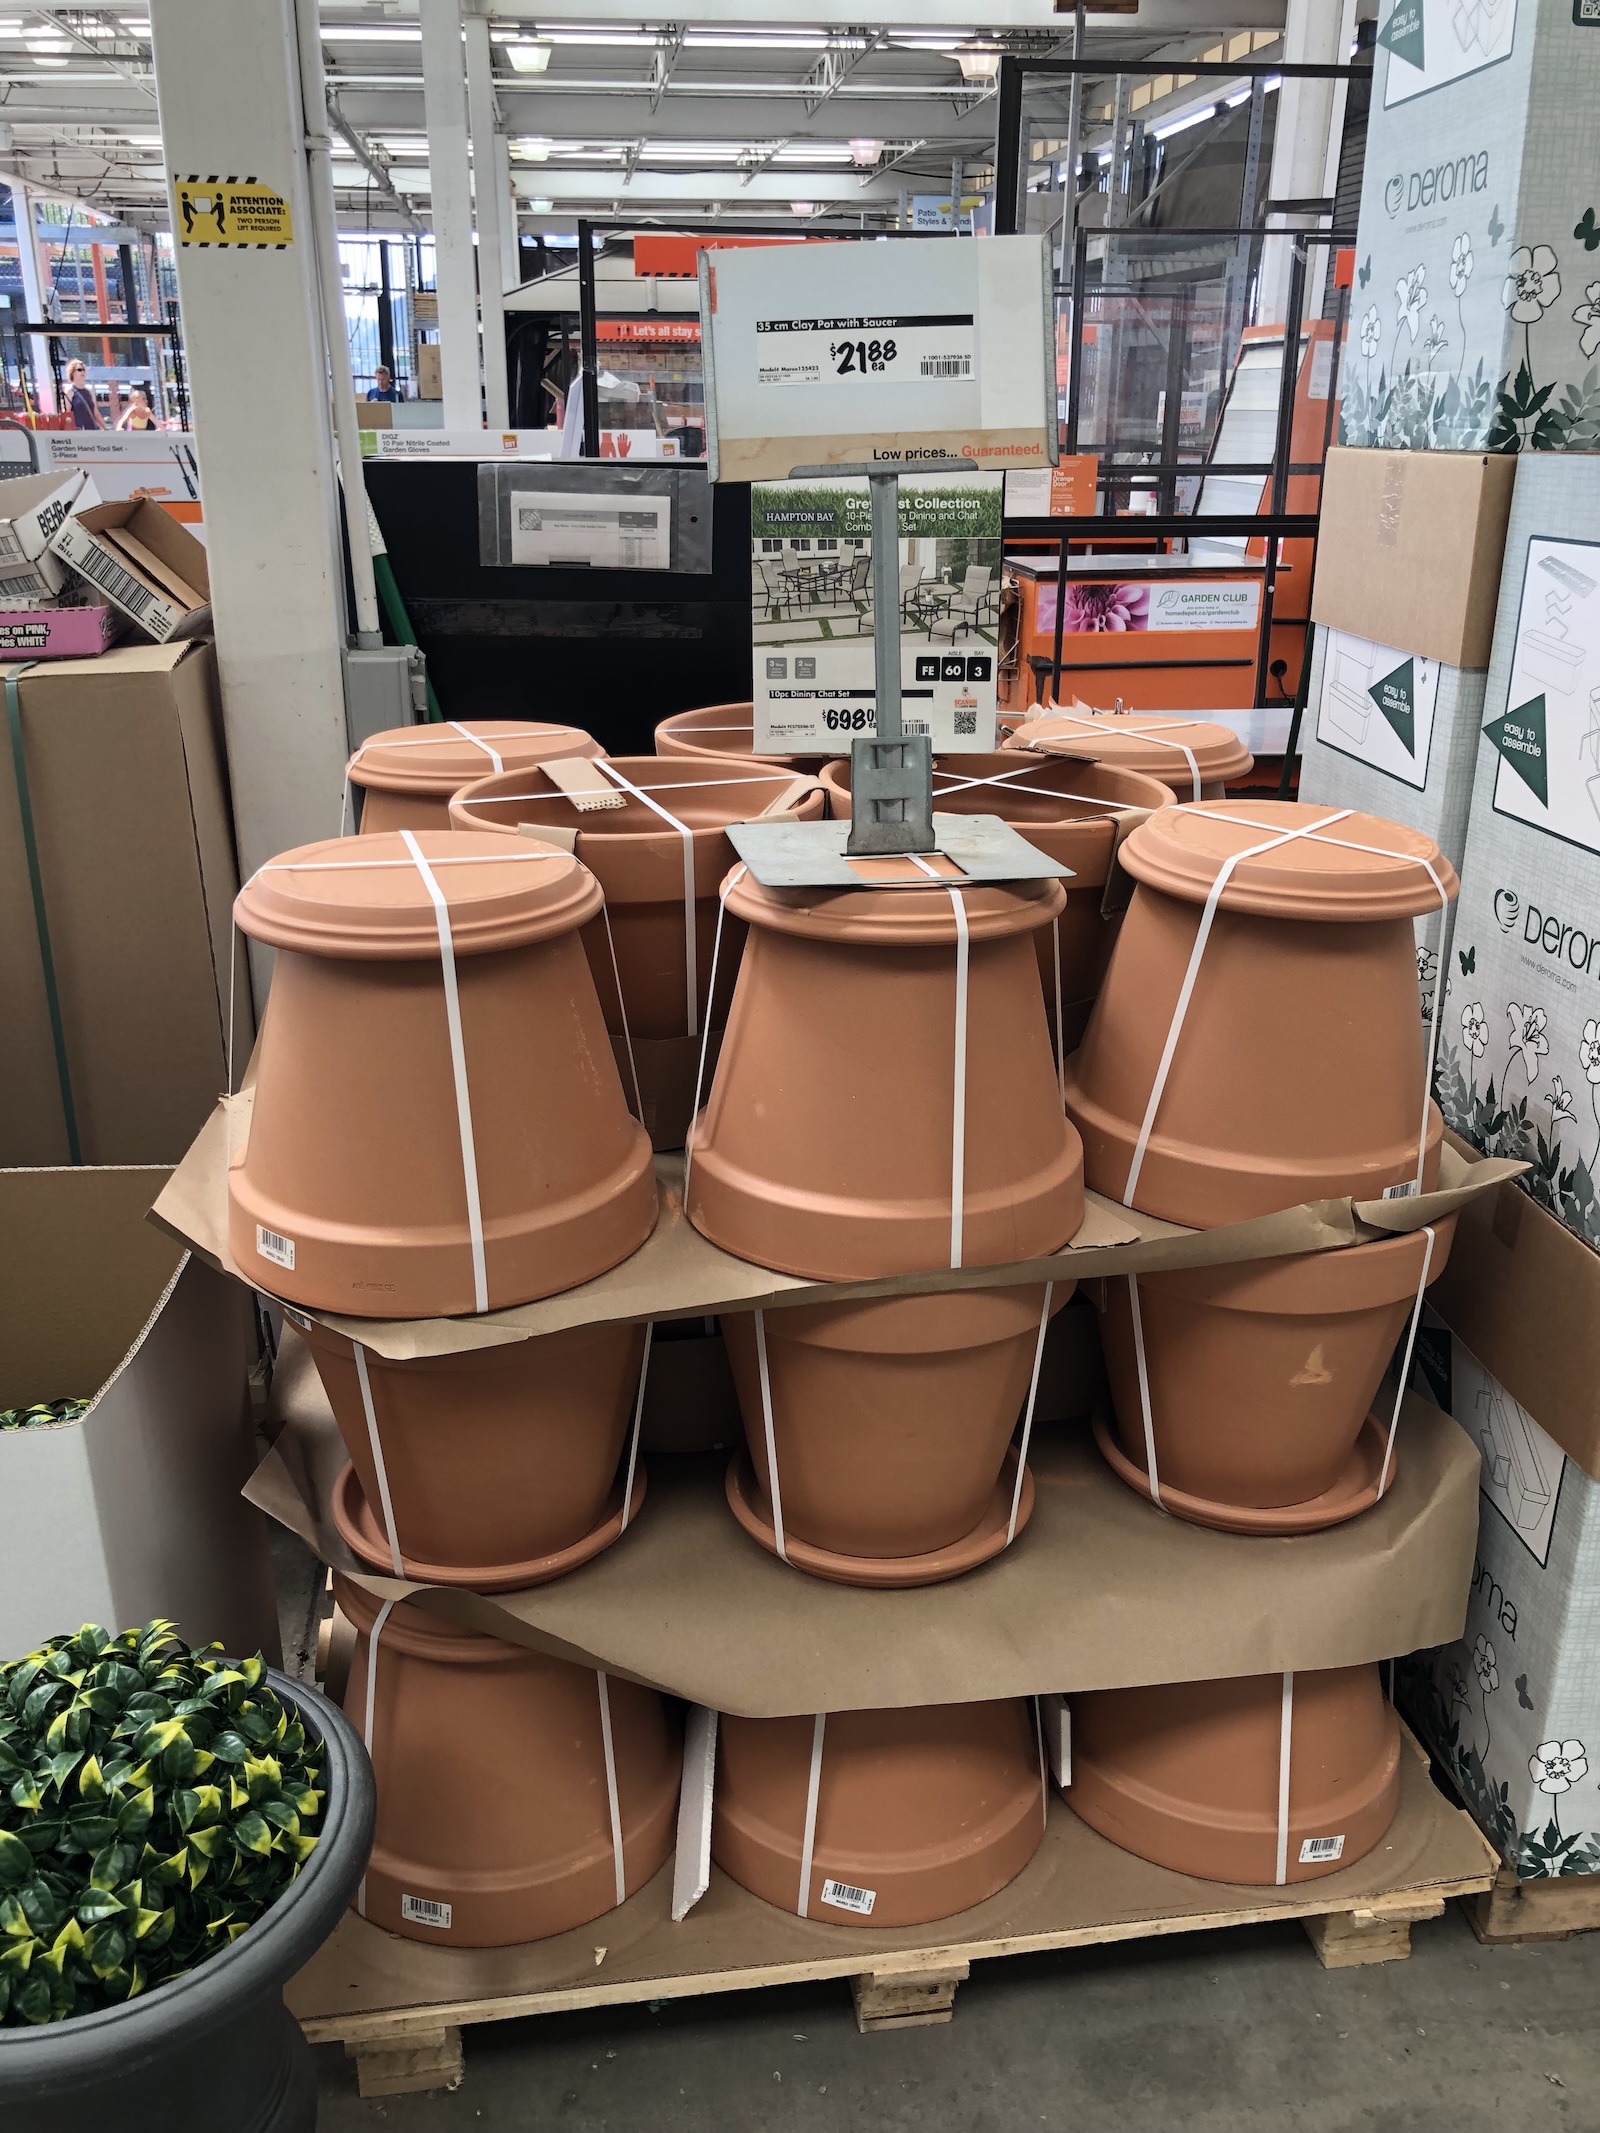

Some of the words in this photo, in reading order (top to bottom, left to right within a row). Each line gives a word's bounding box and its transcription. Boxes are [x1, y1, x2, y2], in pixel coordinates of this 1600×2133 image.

[1392, 12, 1408, 28] easy
[1408, 8, 1416, 20] to
[1391, 18, 1420, 42] assemble
[230, 196, 284, 206] ATTENTION
[230, 206, 286, 215] ASSOCIATE:
[918, 218, 940, 226] Styles
[1405, 217, 1448, 235] www.deroma.com
[757, 322, 770, 332] 35
[773, 322, 788, 330] cm
[791, 320, 814, 332] Clay
[817, 320, 834, 330] Pot
[837, 318, 860, 328] with
[863, 318, 898, 328] Saucer
[633, 326, 656, 336] Let's
[658, 326, 670, 336] all
[672, 326, 692, 338] stay
[871, 361, 886, 372] ea
[873, 448, 900, 461] Low
[904, 448, 958, 462] prices...
[961, 443, 1044, 458] Guaranteed.
[914, 498, 981, 510] Collection
[36, 500, 64, 539] BEHR
[766, 512, 813, 522] HAMPTON
[814, 512, 835, 522] BAY
[909, 512, 936, 522] Dining
[938, 512, 951, 520] and
[956, 510, 978, 520] Chat
[902, 522, 917, 532] Set
[1180, 594, 1220, 603] GARDEN
[1222, 593, 1248, 602] CLUB
[12, 626, 24, 636] on
[25, 624, 50, 636] PINK,
[16, 636, 45, 647] WHITE
[922, 666, 935, 676] FE
[945, 666, 962, 676] 60
[974, 667, 982, 677] 3
[770, 690, 789, 699] 10pc
[791, 690, 816, 699] Dining
[818, 690, 838, 698] Chat
[839, 690, 850, 698] Set
[1384, 683, 1398, 701] easy
[1400, 688, 1407, 700] to
[1382, 695, 1410, 715] assemble
[1504, 722, 1525, 740] easy
[1527, 728, 1536, 741] to
[1502, 734, 1542, 757] assemble
[1520, 954, 1578, 994] www.deroma.com
